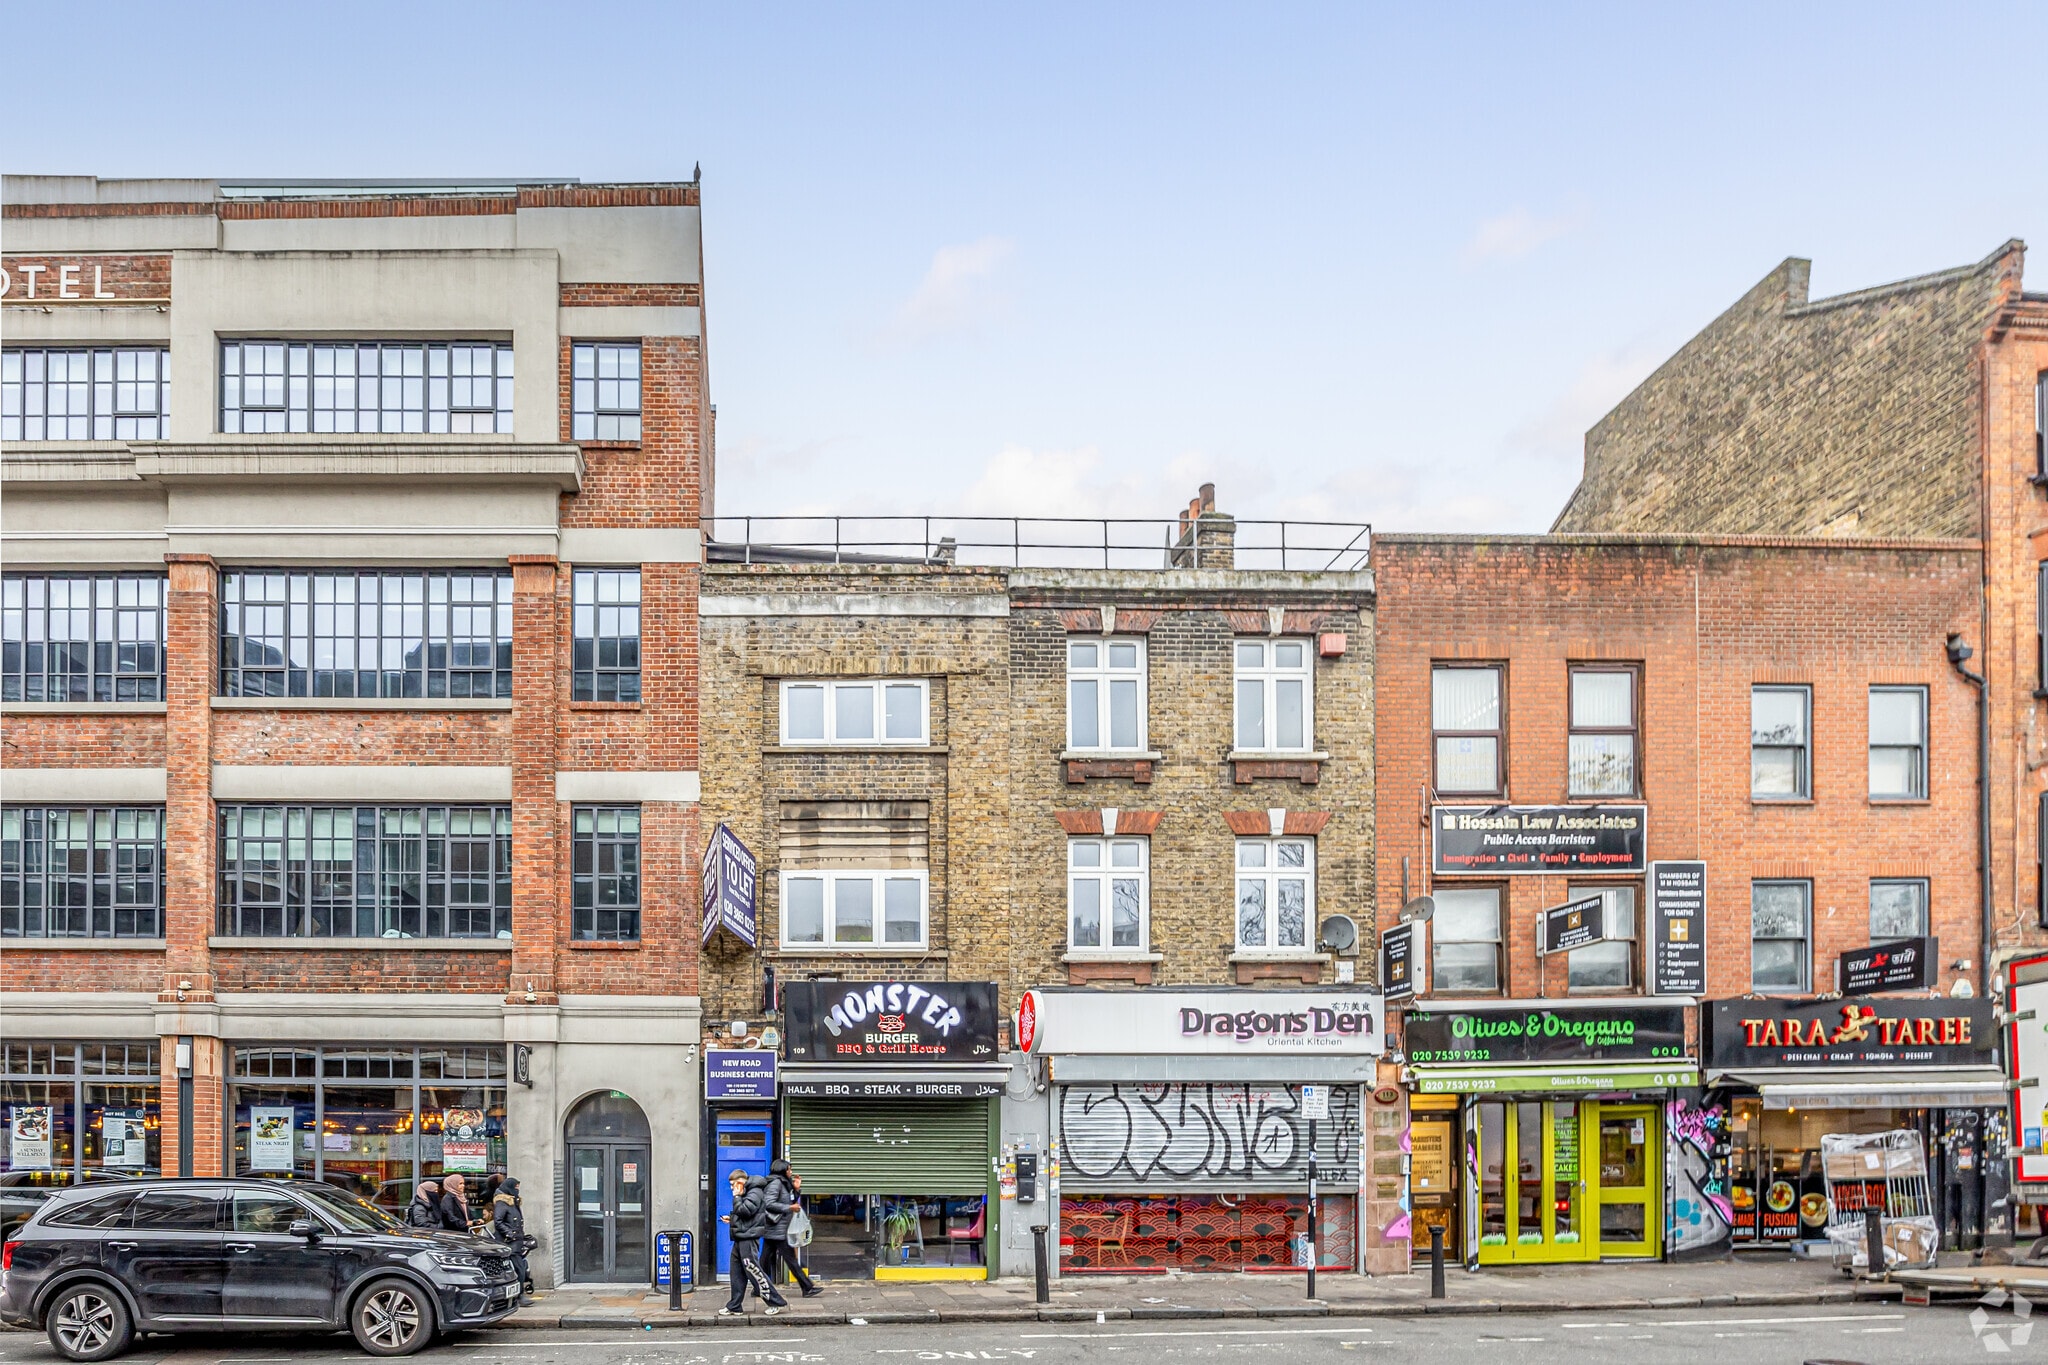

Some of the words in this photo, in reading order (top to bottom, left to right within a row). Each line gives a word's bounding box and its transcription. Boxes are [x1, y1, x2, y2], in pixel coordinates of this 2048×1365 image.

[1458, 815, 1518, 830] Hossain
[1522, 815, 1552, 830] Law
[1556, 814, 1637, 830] Associates
[1484, 834, 1513, 845] Public
[1514, 834, 1546, 844] Access
[1548, 834, 1596, 844] Barristers
[1443, 854, 1496, 865] Immigration
[1508, 854, 1528, 862] Civil
[1539, 854, 1569, 864] Family
[1578, 853, 1633, 864] Employment
[724, 854, 738, 886] TO
[739, 867, 754, 900] LET
[1583, 898, 1600, 910] EXPERTS
[824, 984, 960, 1036] MONSTER
[1308, 1006, 1374, 1034] Den
[1412, 1012, 1430, 1022] 113
[1452, 1018, 1524, 1038] Olives
[1526, 1014, 1541, 1036] &
[1543, 1014, 1635, 1046] Oregano
[1741, 1018, 1830, 1046] TARA
[1876, 1016, 1972, 1045] TAREE
[866, 1034, 918, 1044] BURGER
[1268, 1037, 1304, 1046] Oriental
[1307, 1037, 1342, 1046] Kitchen
[836, 1044, 862, 1055] BBQ
[866, 1045, 875, 1053] &
[879, 1044, 906, 1054] Grill
[910, 1044, 946, 1054] House
[973, 1045, 991, 1054] حلال
[1412, 1051, 1431, 1061] 020
[1435, 1050, 1461, 1061] 7539
[1464, 1050, 1490, 1060] 9232
[1426, 1081, 1443, 1090] 020
[1445, 1080, 1469, 1090] 7539
[1471, 1080, 1496, 1089] 9232
[1552, 1077, 1575, 1085] Olives
[1582, 1076, 1613, 1087] Oregano
[826, 1085, 849, 1094] BBQ
[865, 1085, 900, 1094] STEAK
[916, 1085, 962, 1094] BURGER
[976, 1084, 999, 1096] حلال
[1554, 1164, 1577, 1172] CAKES
[1738, 1214, 1754, 1226] MADE
[1764, 1214, 1797, 1226] FUSION
[1764, 1228, 1797, 1236] PLATTER
[916, 1350, 1036, 1360] ONLY
